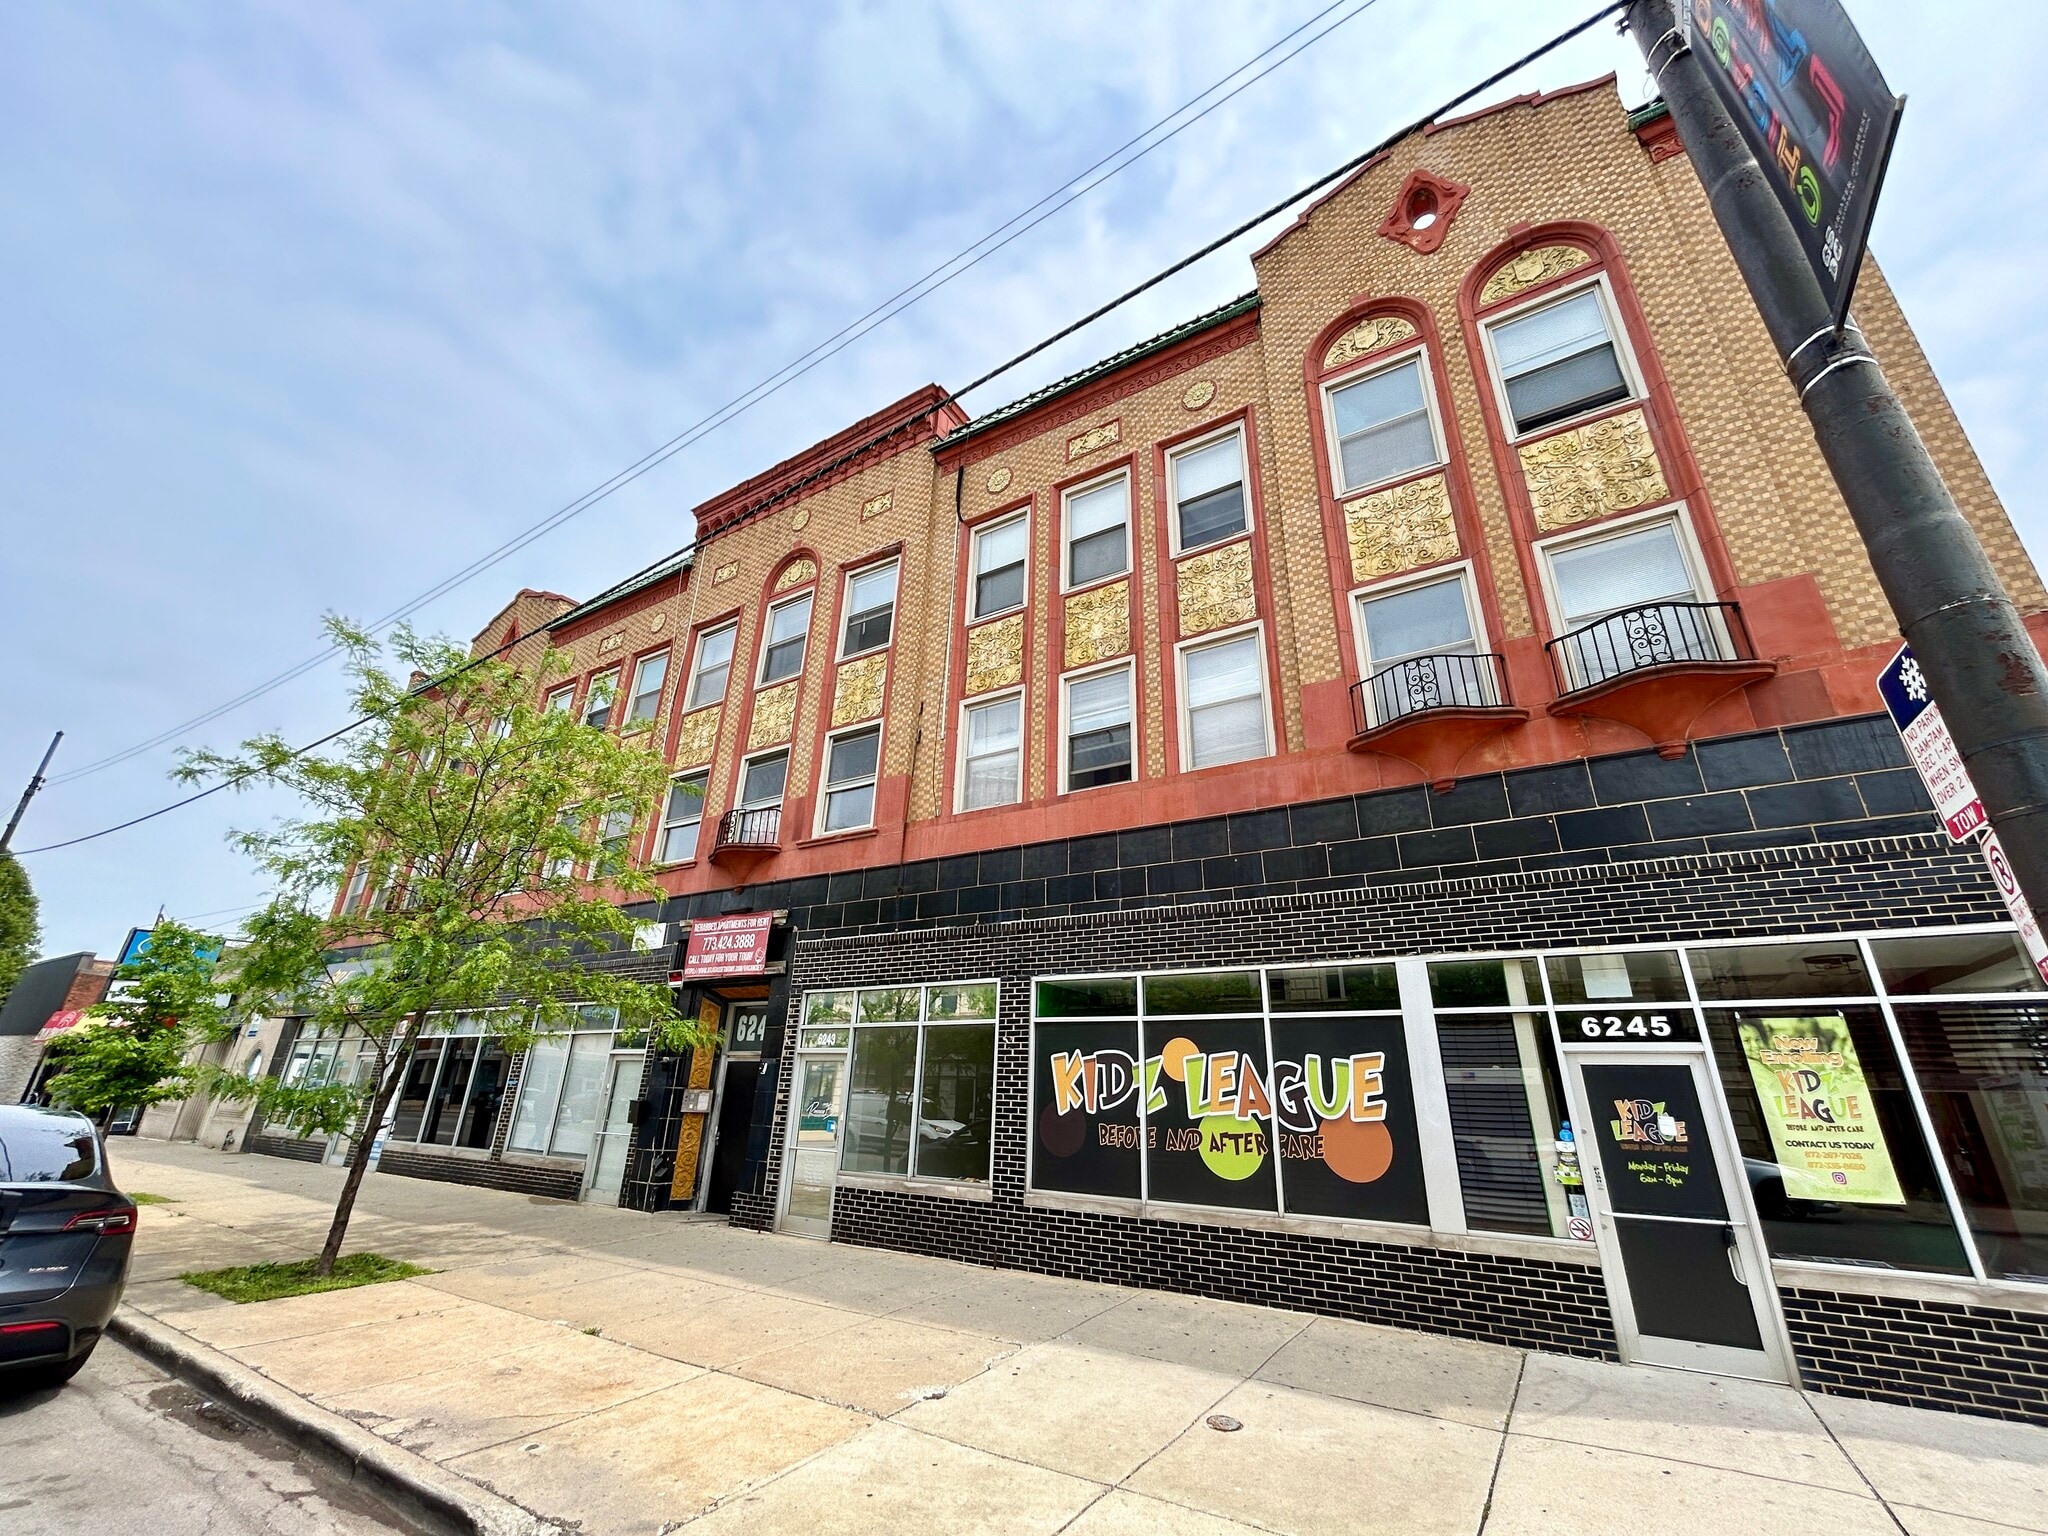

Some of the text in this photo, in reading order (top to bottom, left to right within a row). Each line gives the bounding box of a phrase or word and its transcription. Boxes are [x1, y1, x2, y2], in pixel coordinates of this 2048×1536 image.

[1906, 727, 1918, 742] NO
[1914, 725, 1945, 759] 3AM-7AM
[1920, 753, 1936, 773] DEC
[1928, 763, 1950, 789] WHEN
[1936, 782, 1958, 805] OVER
[1956, 776, 1965, 790] 2
[1952, 805, 1979, 835] TOW
[747, 918, 757, 928] FOR
[757, 916, 770, 927] RENT
[702, 933, 756, 951] 773.424.3888
[688, 954, 700, 965] CALL
[700, 953, 715, 964] TODAY
[715, 953, 725, 963] FOR
[725, 952, 738, 963] YOUR
[1581, 1015, 1671, 1037] 6245
[1773, 1034, 1818, 1050] Now
[1759, 1049, 1845, 1068] Enrolling
[1051, 1048, 1388, 1133] KIDZ LEAGUE
[1774, 1069, 1840, 1095] KIDZ
[1773, 1094, 1863, 1124] LEAGUE
[1785, 1123, 1808, 1132] BEFORE
[1846, 1125, 1865, 1133] CARE
[1165, 1127, 1203, 1152] AND
[1209, 1131, 1269, 1157] AFTER
[1785, 1139, 1875, 1150] CONTACT US TODAY
[1628, 1161, 1657, 1173] Monday
[1663, 1162, 1689, 1175] Friday
